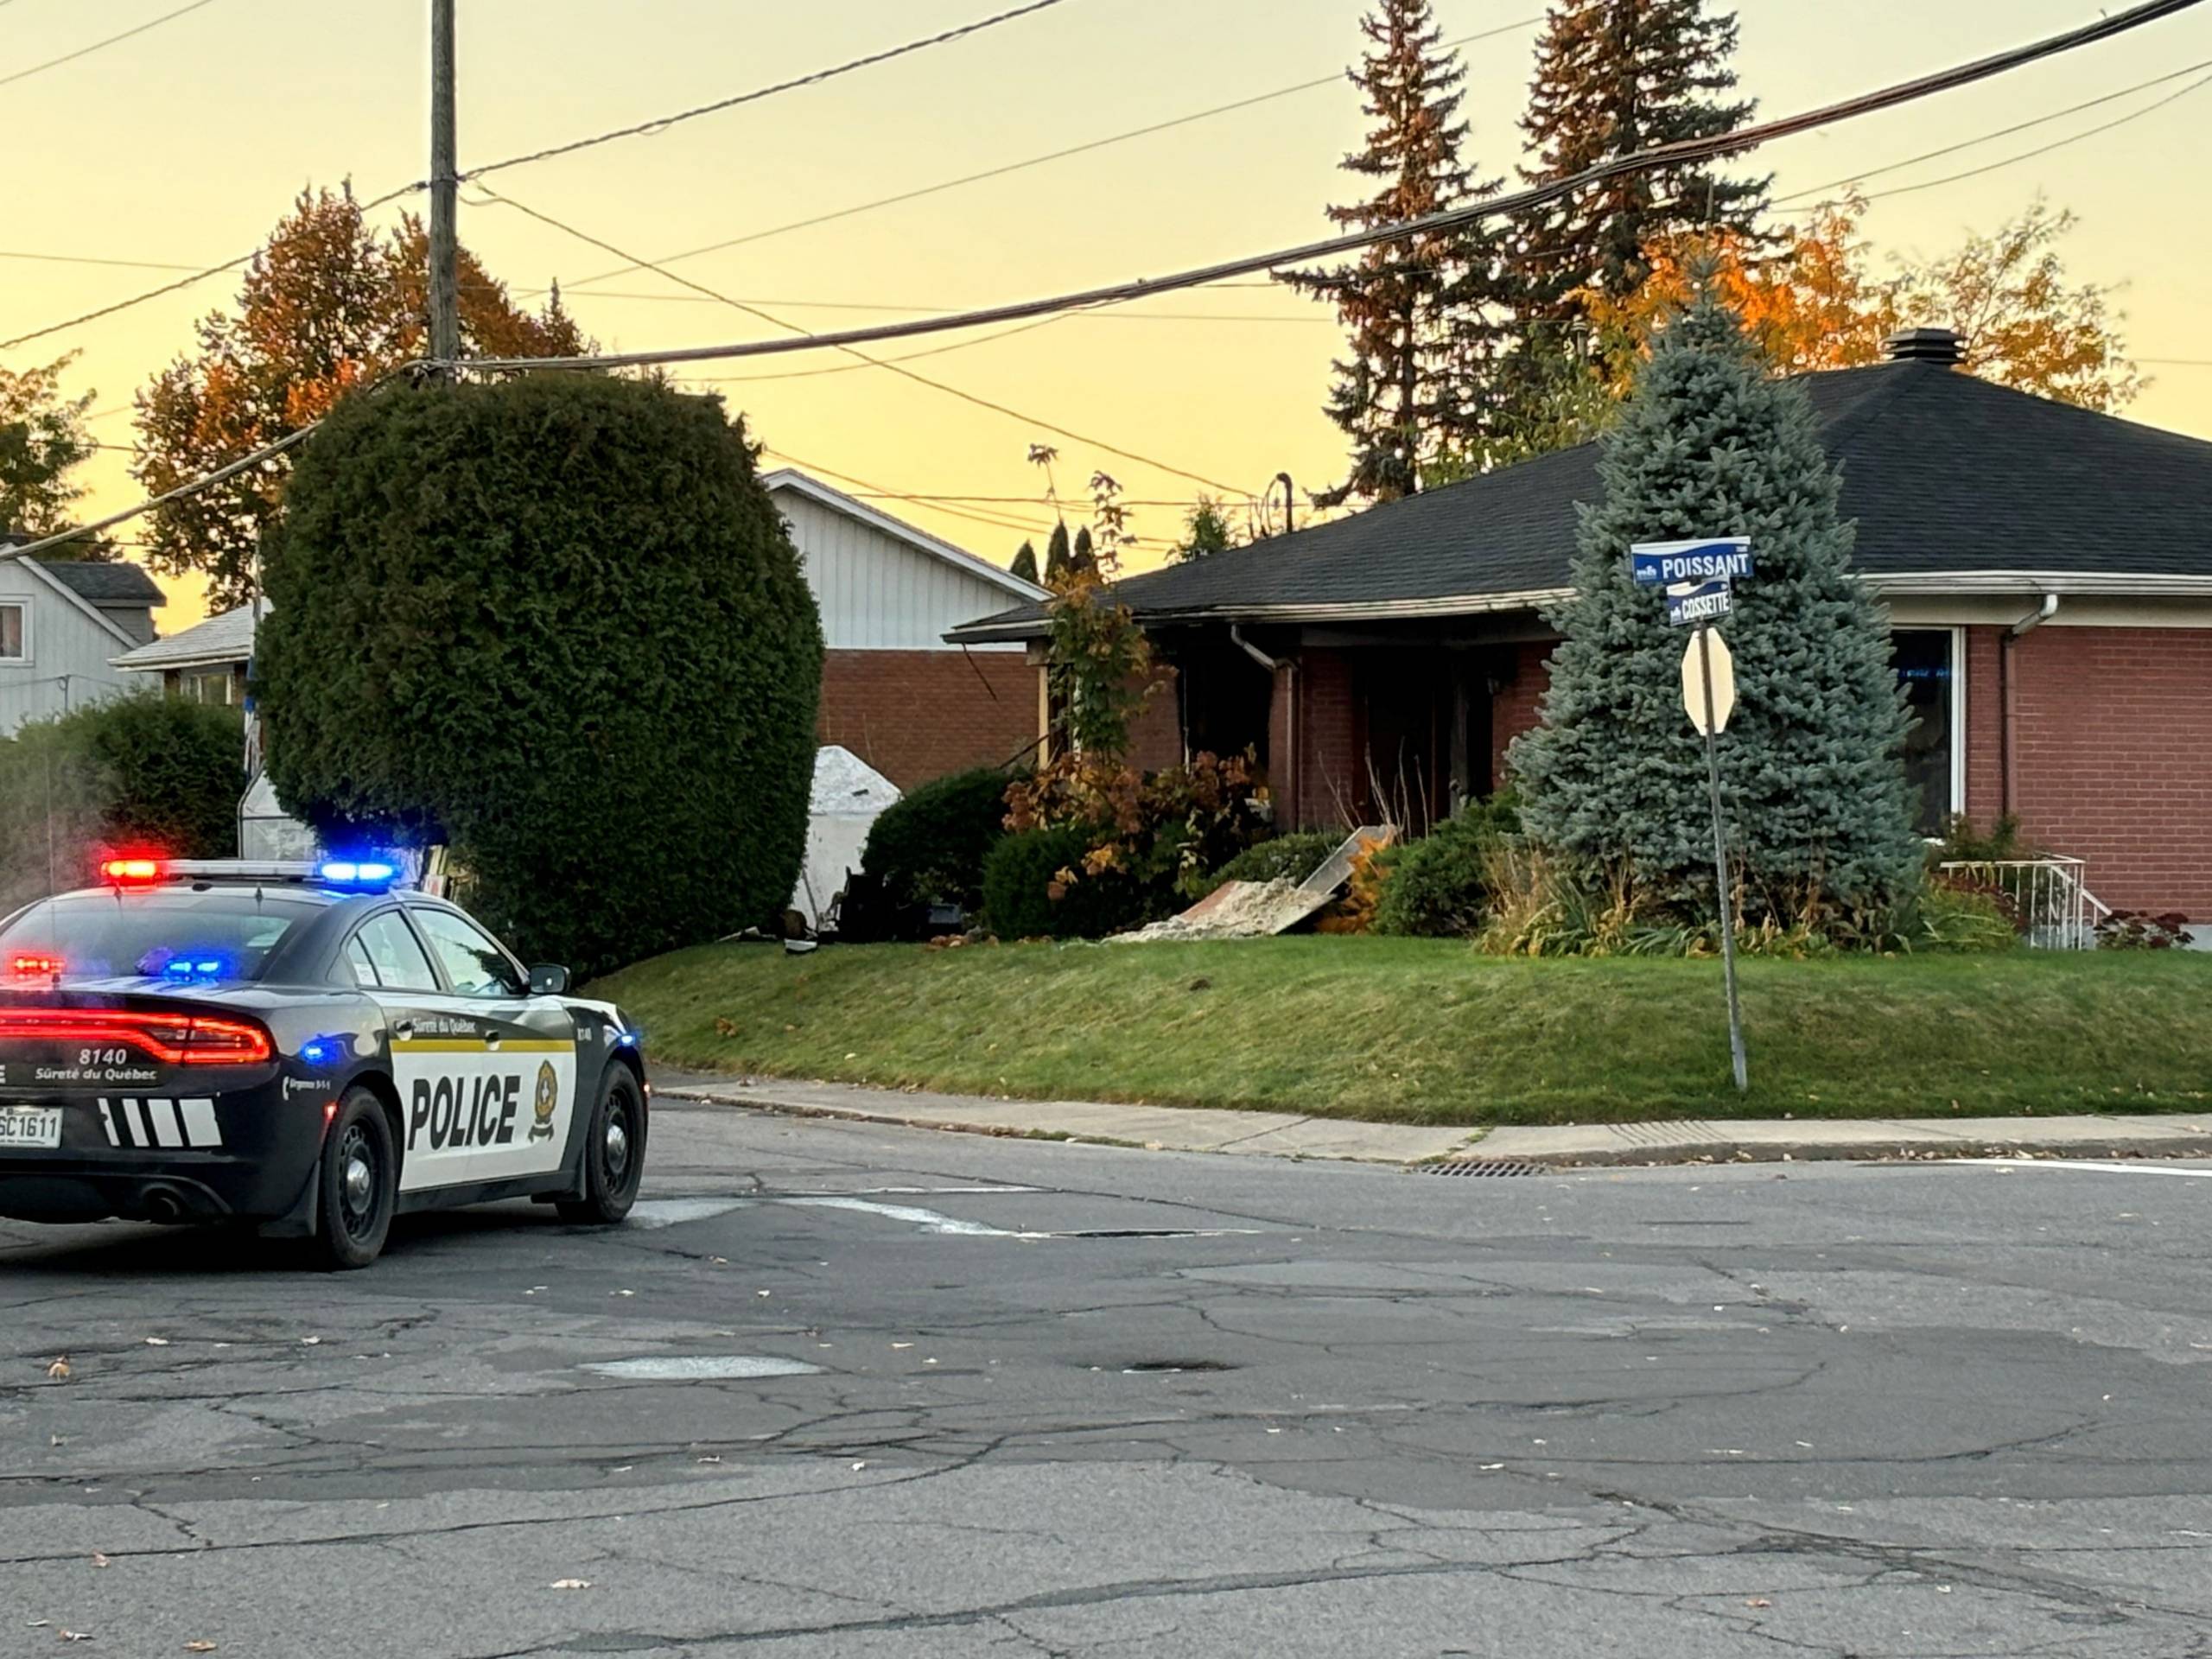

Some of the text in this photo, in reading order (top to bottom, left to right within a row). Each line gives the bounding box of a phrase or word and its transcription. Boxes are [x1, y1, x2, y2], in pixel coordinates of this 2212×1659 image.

[1662, 554, 1749, 579] POISSANT
[1681, 591, 1729, 620] COSSETTE
[79, 1048, 127, 1065] 8140
[35, 1067, 157, 1082] Sûreté du Québec
[407, 1074, 521, 1151] POLICE
